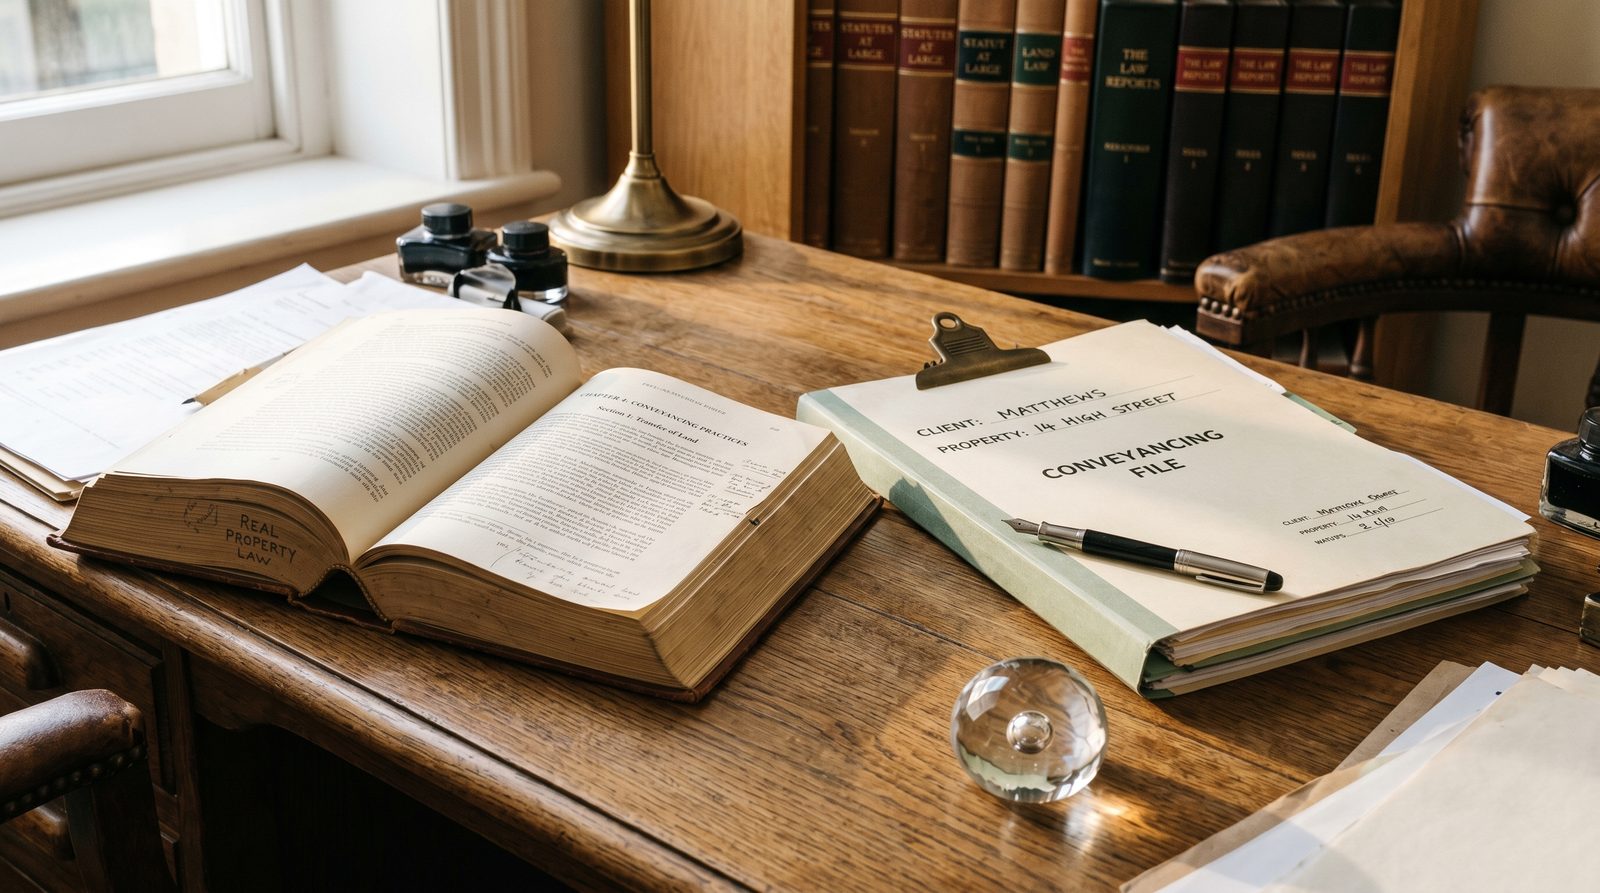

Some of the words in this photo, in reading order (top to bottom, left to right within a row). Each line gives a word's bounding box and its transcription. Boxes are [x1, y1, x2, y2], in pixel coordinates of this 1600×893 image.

[842, 23, 893, 34] STATUTES
[859, 36, 872, 46] AT
[919, 42, 933, 52] AT
[977, 51, 992, 61] AT
[1022, 46, 1055, 58] LAND
[1123, 48, 1148, 60] THE
[1024, 61, 1050, 71] LAW
[1120, 63, 1148, 74] LAW
[1105, 75, 1160, 89] REPORTS
[580, 392, 620, 401] CHAPTER
[630, 400, 699, 430] CONVEYANCING
[700, 426, 749, 448] PRACTICES
[916, 418, 983, 438] CLIENT:
[997, 388, 1107, 420] MATTHEWS
[596, 405, 625, 417] Section
[636, 416, 667, 432] Transfer
[668, 428, 678, 436] of
[677, 431, 700, 445] Land
[937, 429, 1029, 454] PROPERTY:
[1034, 422, 1056, 434] 14
[1061, 410, 1107, 426] HIGH
[1111, 392, 1177, 414] STREET
[1042, 429, 1225, 479] CONVEYANCING
[1129, 458, 1187, 478] FILE
[240, 513, 279, 539] REAL
[226, 528, 297, 564] PROPERTY
[236, 547, 272, 566] LAW
